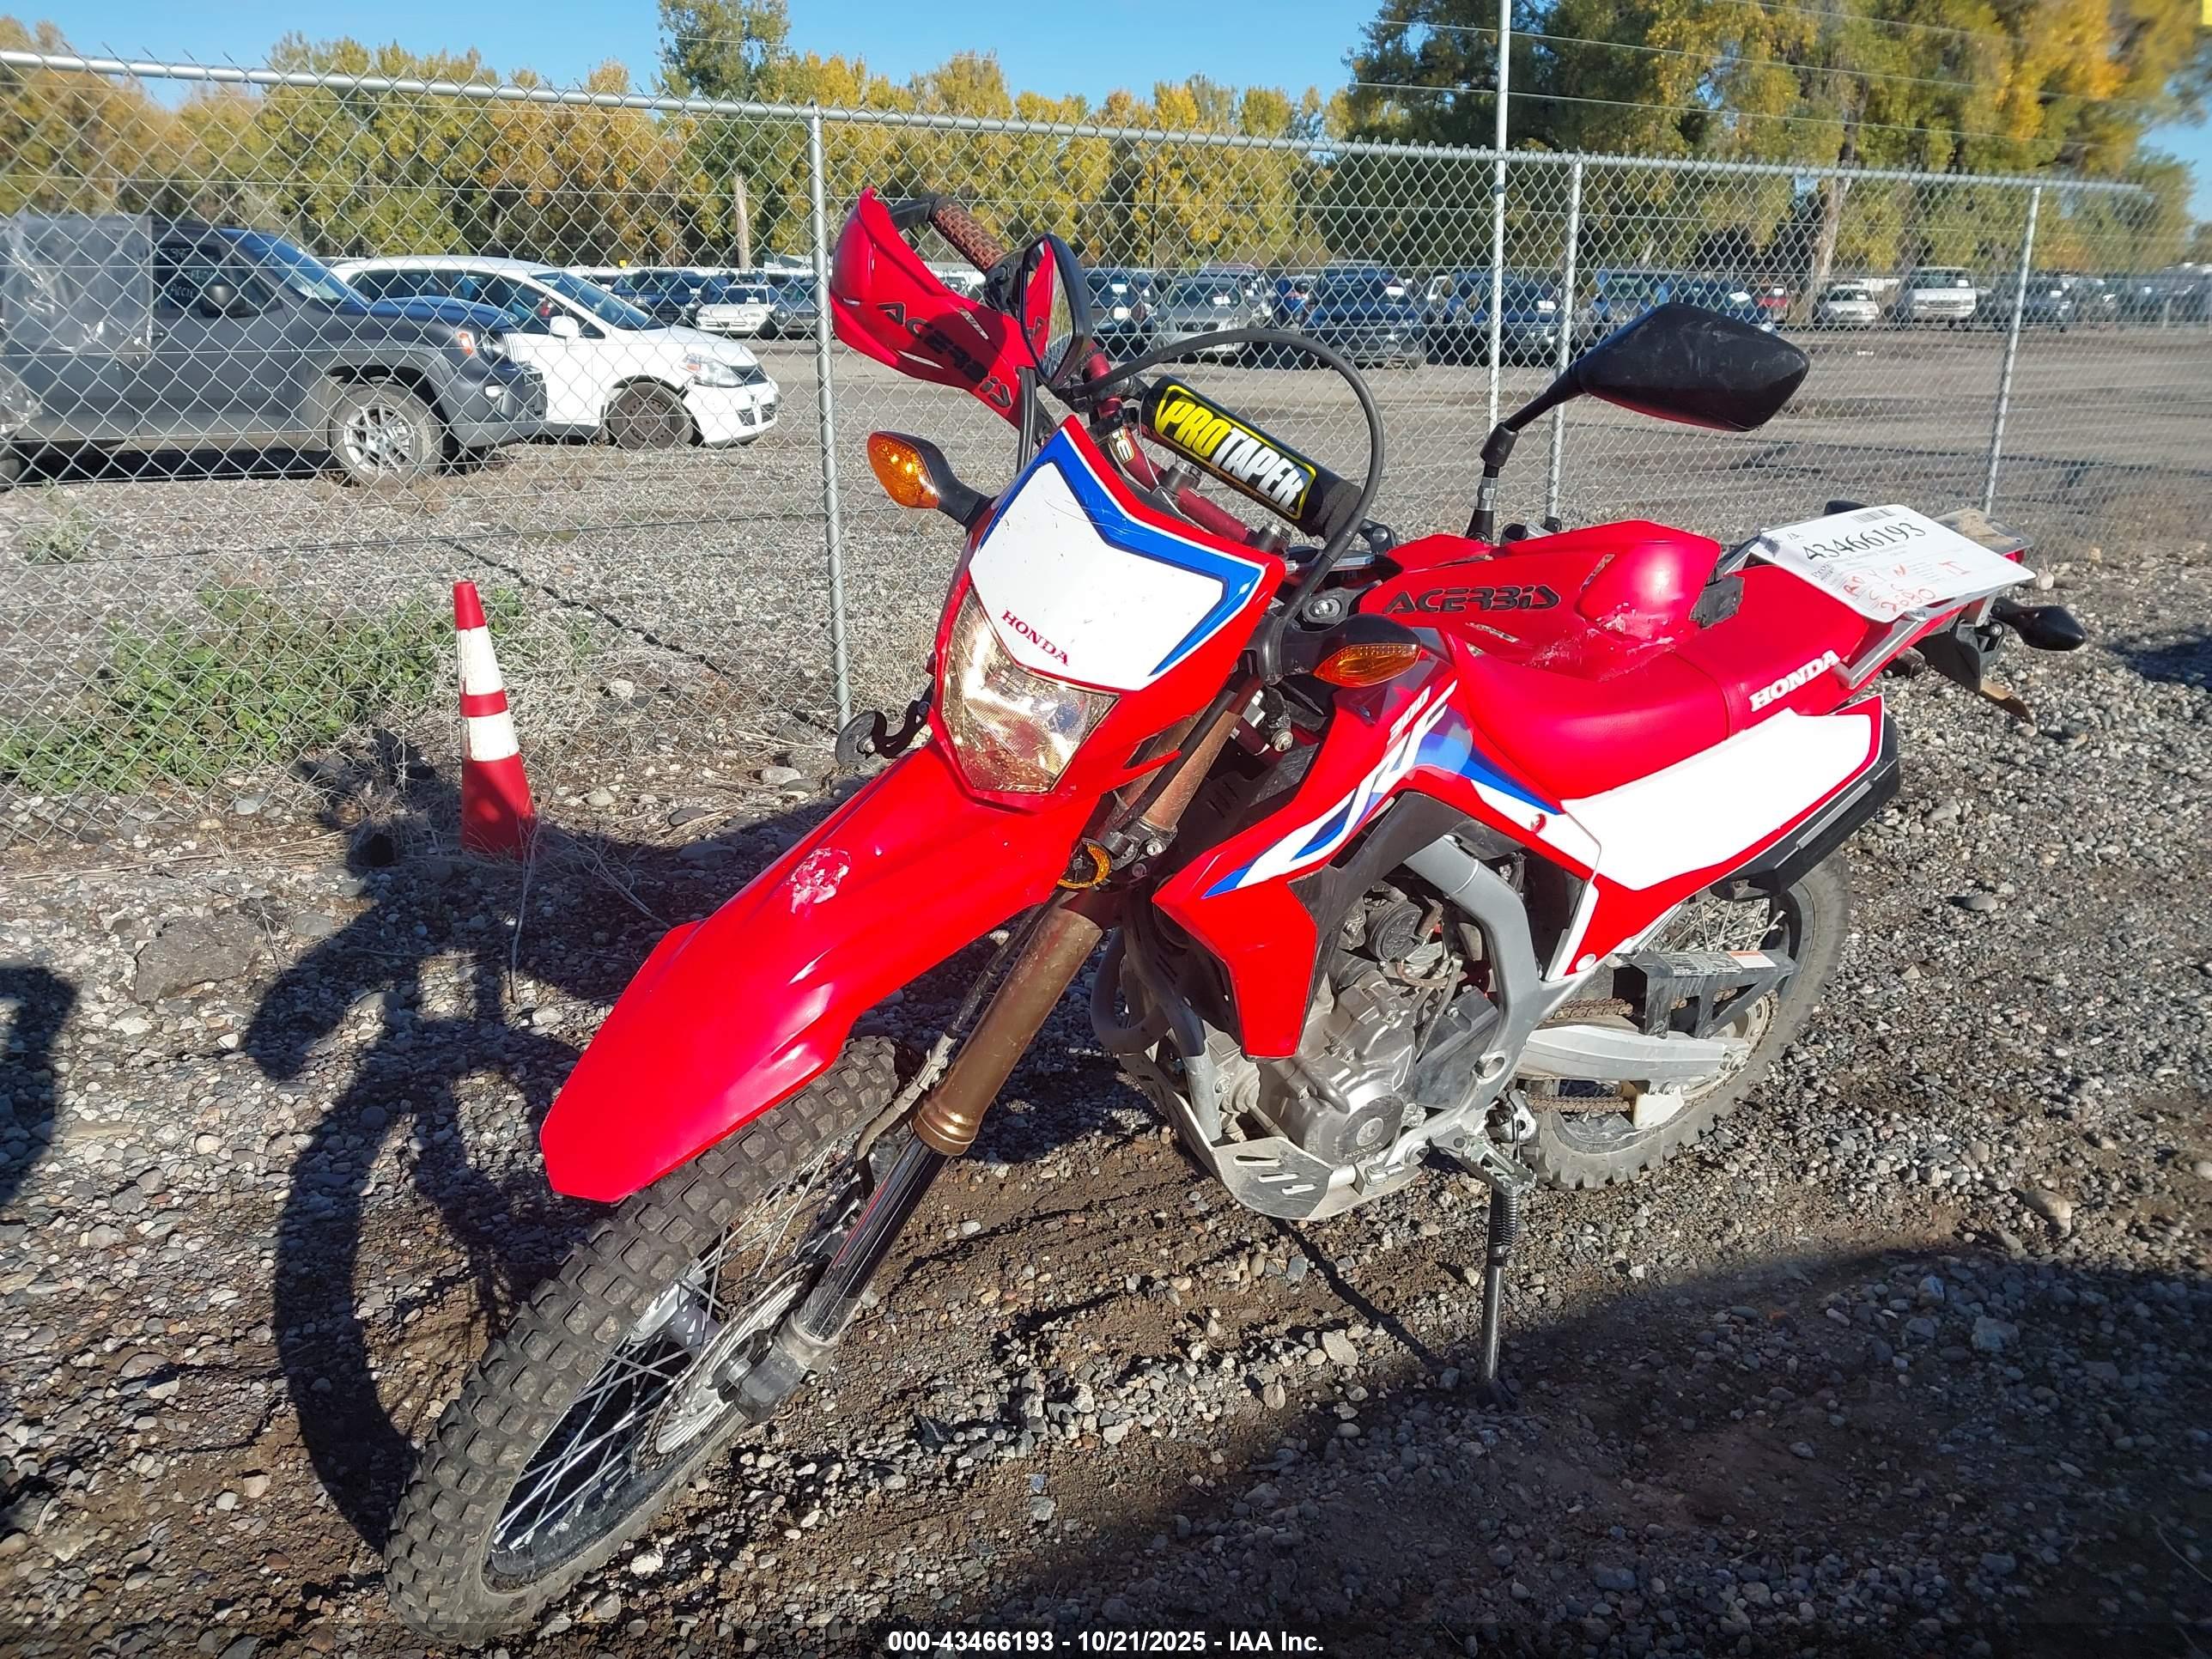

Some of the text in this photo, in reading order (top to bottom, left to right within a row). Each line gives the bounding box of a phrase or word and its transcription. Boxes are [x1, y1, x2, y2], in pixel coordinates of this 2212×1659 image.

[1802, 522, 1926, 560] 43466193
[1383, 583, 1561, 615] ACERBIS
[1001, 610, 1068, 666] HONDA
[1748, 649, 1841, 713] HONDA
